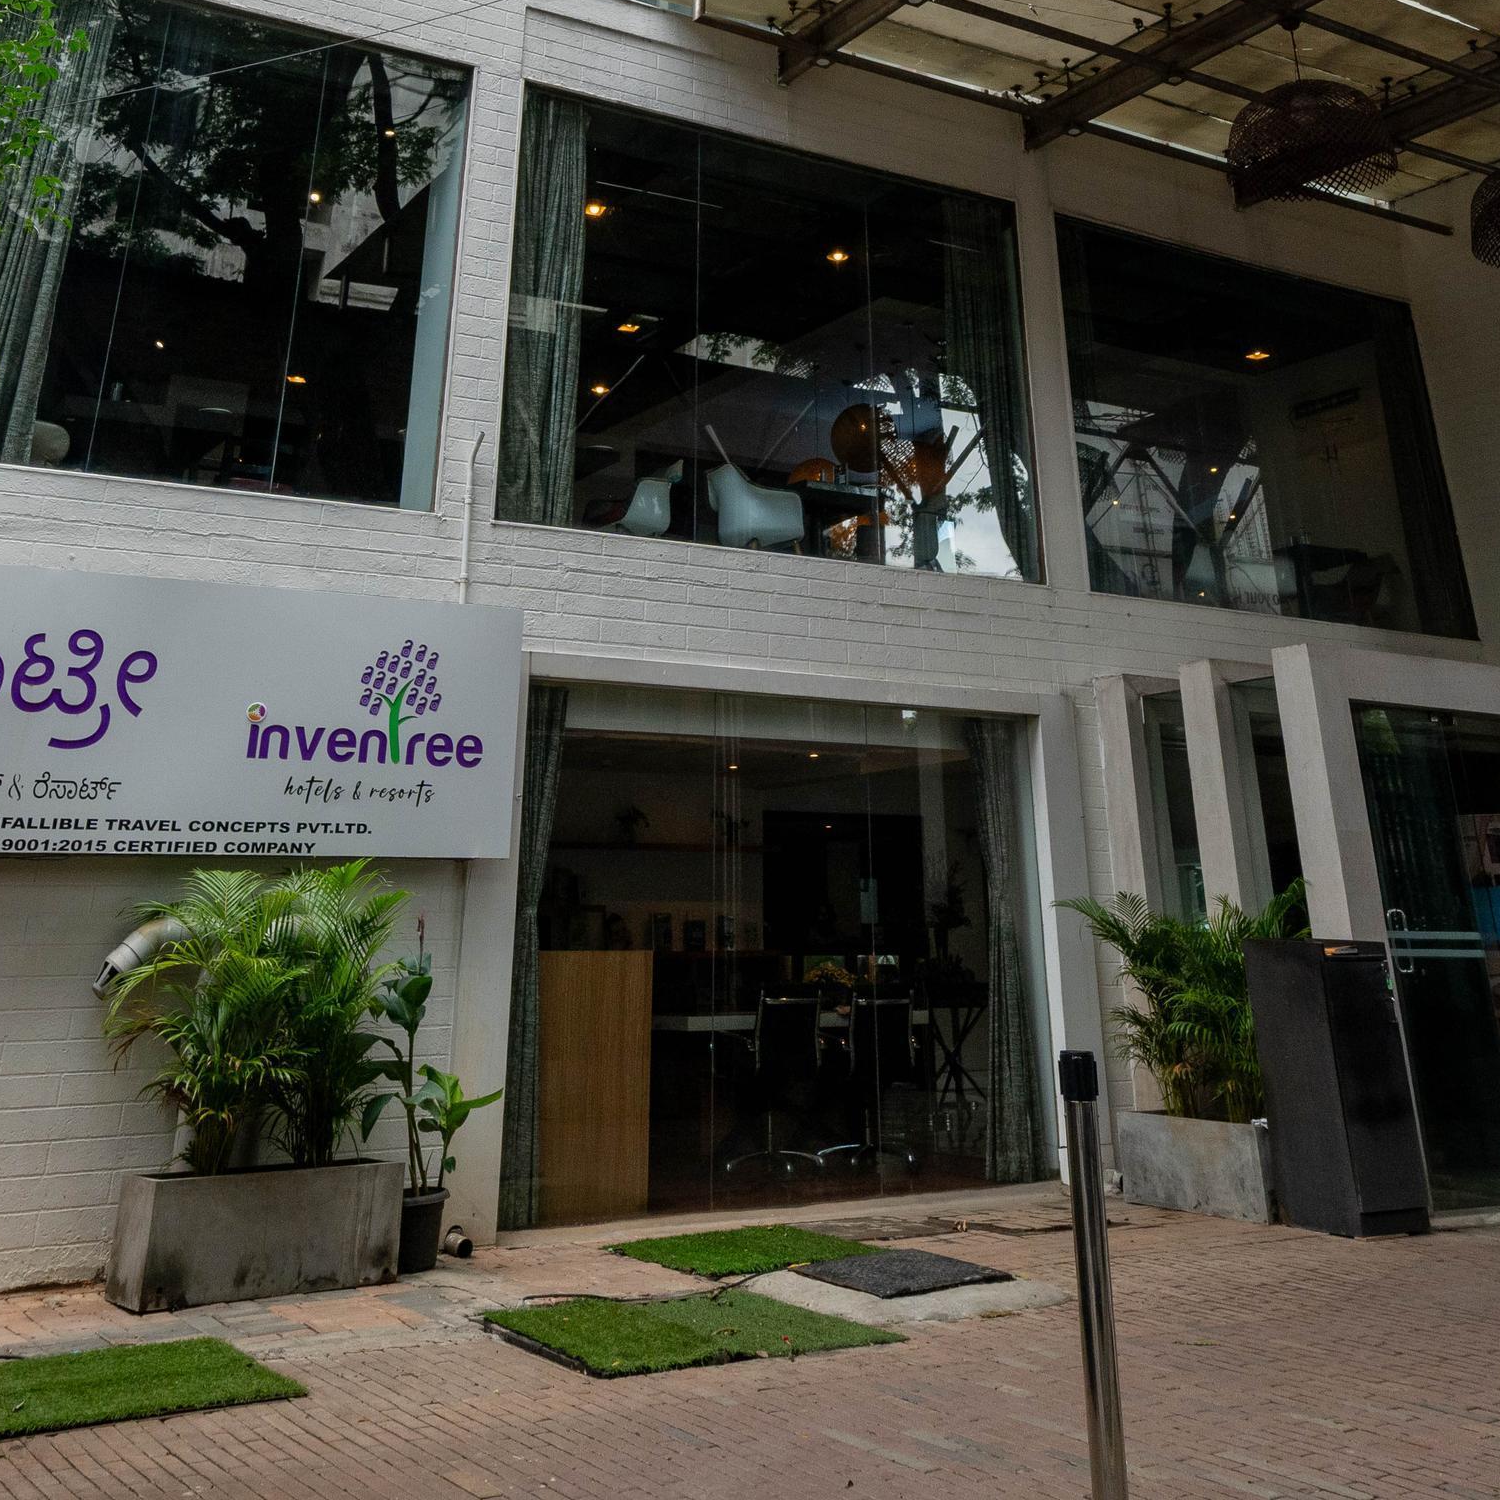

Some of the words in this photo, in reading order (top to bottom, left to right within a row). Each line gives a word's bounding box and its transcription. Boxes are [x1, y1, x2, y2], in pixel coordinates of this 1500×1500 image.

[284, 776, 345, 804] hotels
[353, 781, 362, 800] &
[370, 780, 435, 807] resorts
[105, 819, 182, 832] TRAVEL
[188, 820, 290, 834] CONCEPTS
[296, 822, 373, 835] PVT.LTD.
[1, 838, 107, 852] 9001:2015
[113, 840, 217, 853] CERTIFIED
[223, 841, 316, 854] COMPANY
